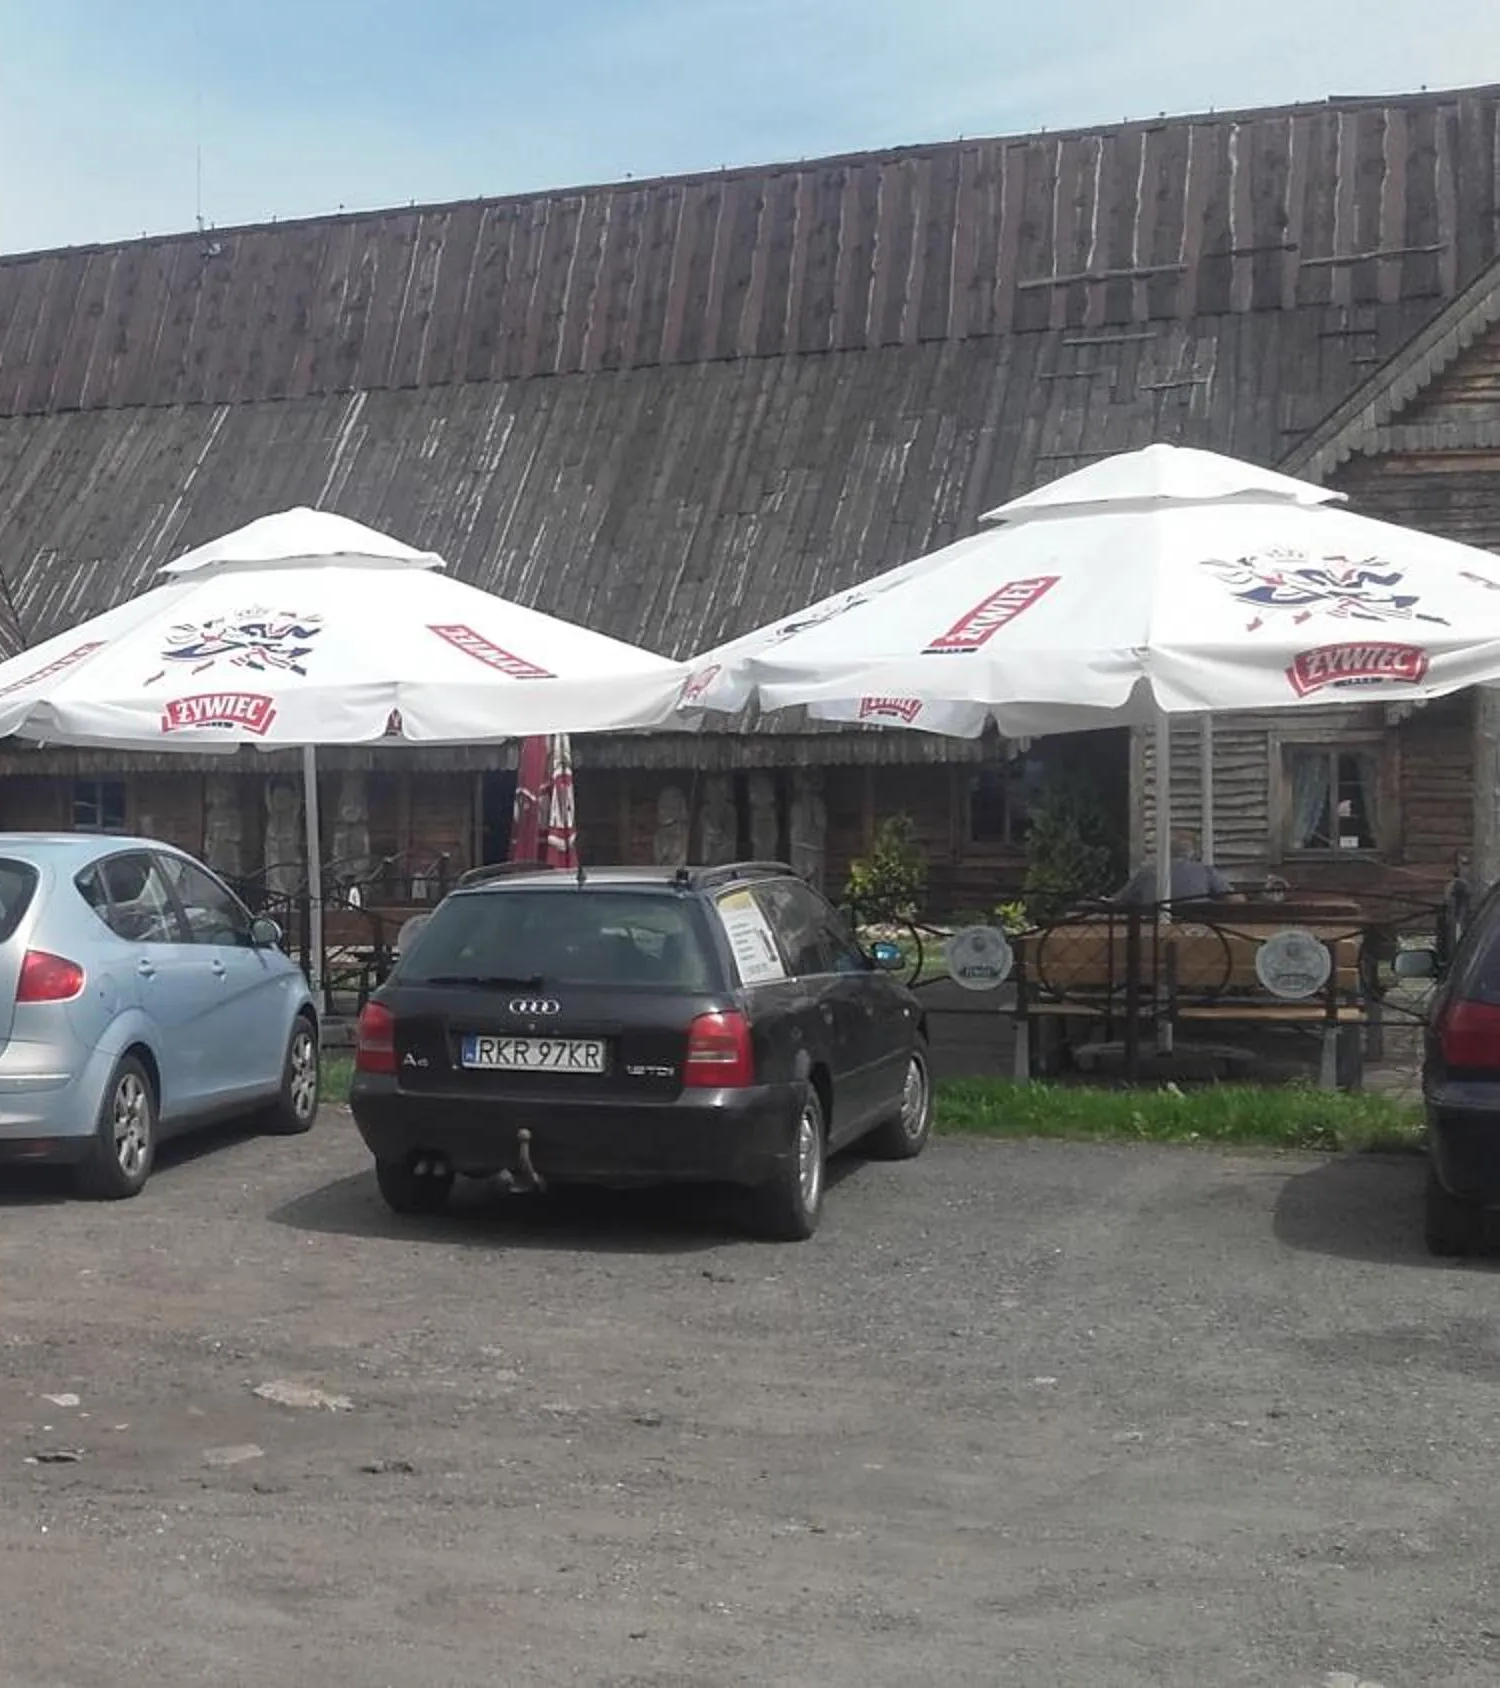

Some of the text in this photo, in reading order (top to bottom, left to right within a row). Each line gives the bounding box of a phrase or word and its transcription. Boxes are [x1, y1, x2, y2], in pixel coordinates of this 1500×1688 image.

[1306, 647, 1415, 679] ŻYWIEC
[175, 694, 264, 722] ŻYWIEC
[478, 1038, 600, 1068] RKR 97KR
